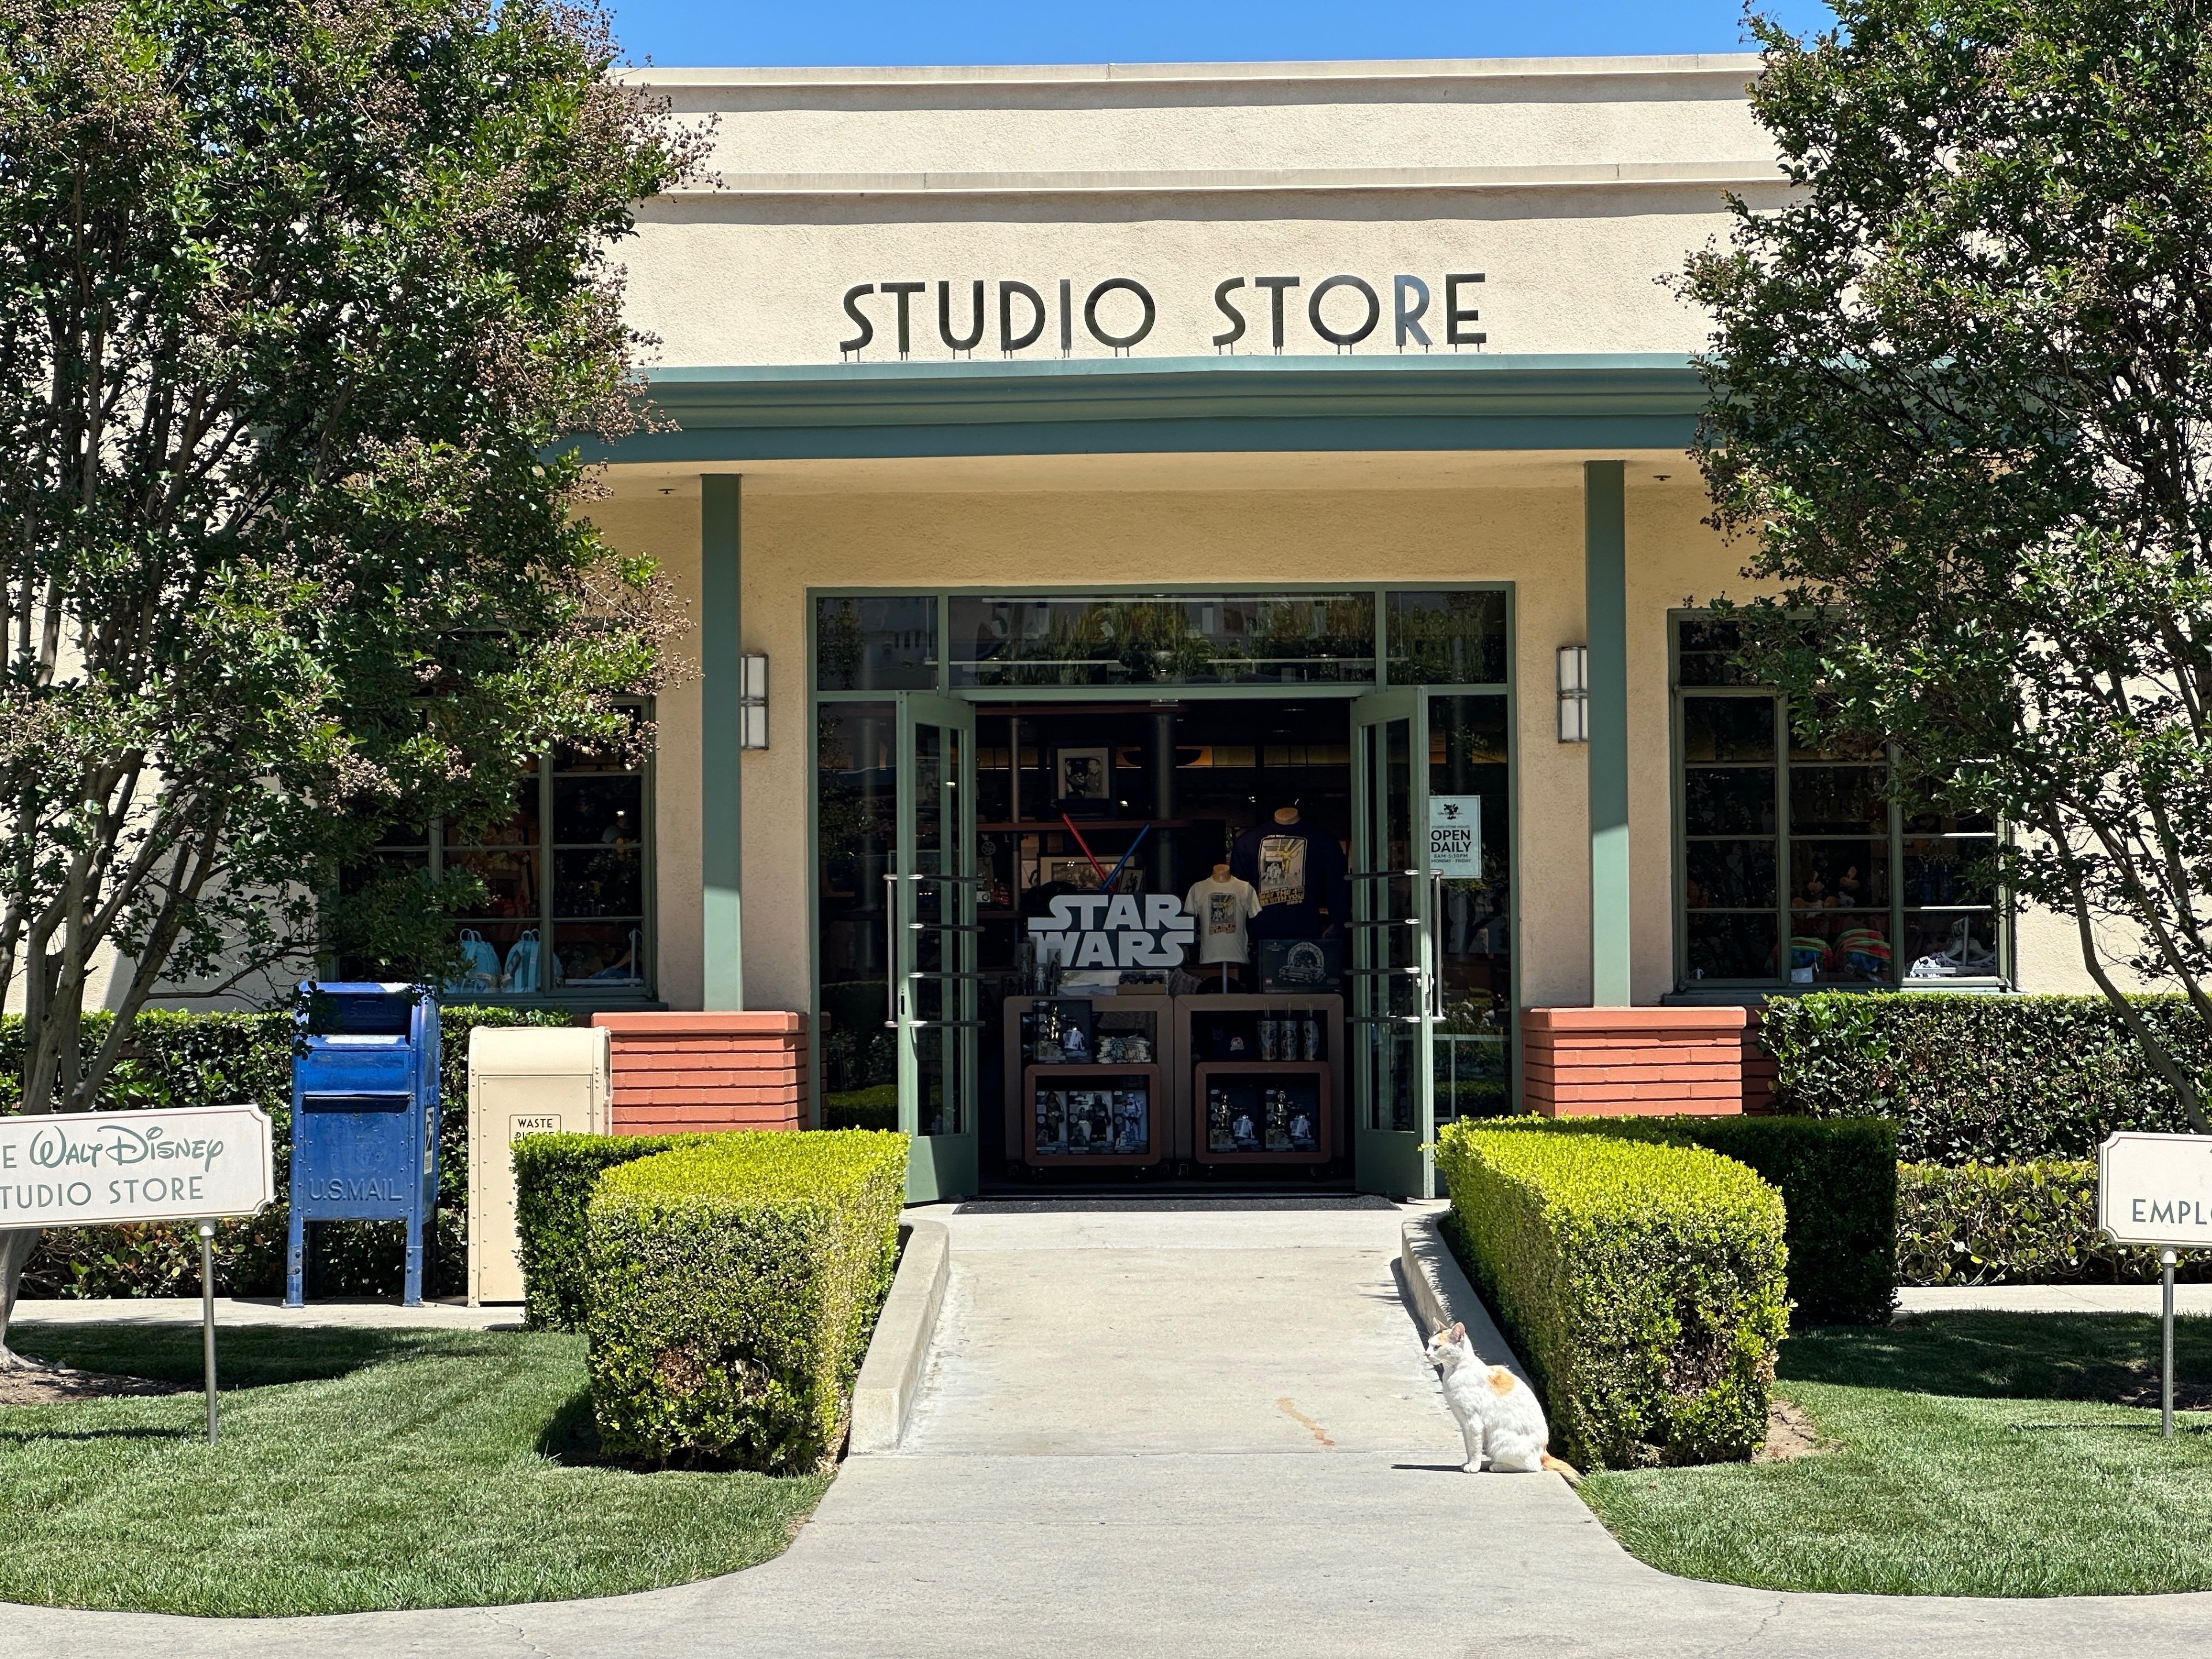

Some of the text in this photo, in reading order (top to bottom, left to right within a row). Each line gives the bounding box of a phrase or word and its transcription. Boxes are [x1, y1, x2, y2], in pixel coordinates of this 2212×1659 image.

[840, 273, 1486, 352] STUDIO STORE
[1431, 830, 1470, 840] OPEN
[1431, 842, 1472, 852] DAILY
[1027, 894, 1194, 930] STAR
[1027, 931, 1194, 967] WARS
[517, 1118, 553, 1128] WASTE
[109, 1176, 204, 1204] STORE
[2132, 1199, 2212, 1225] EMPL
